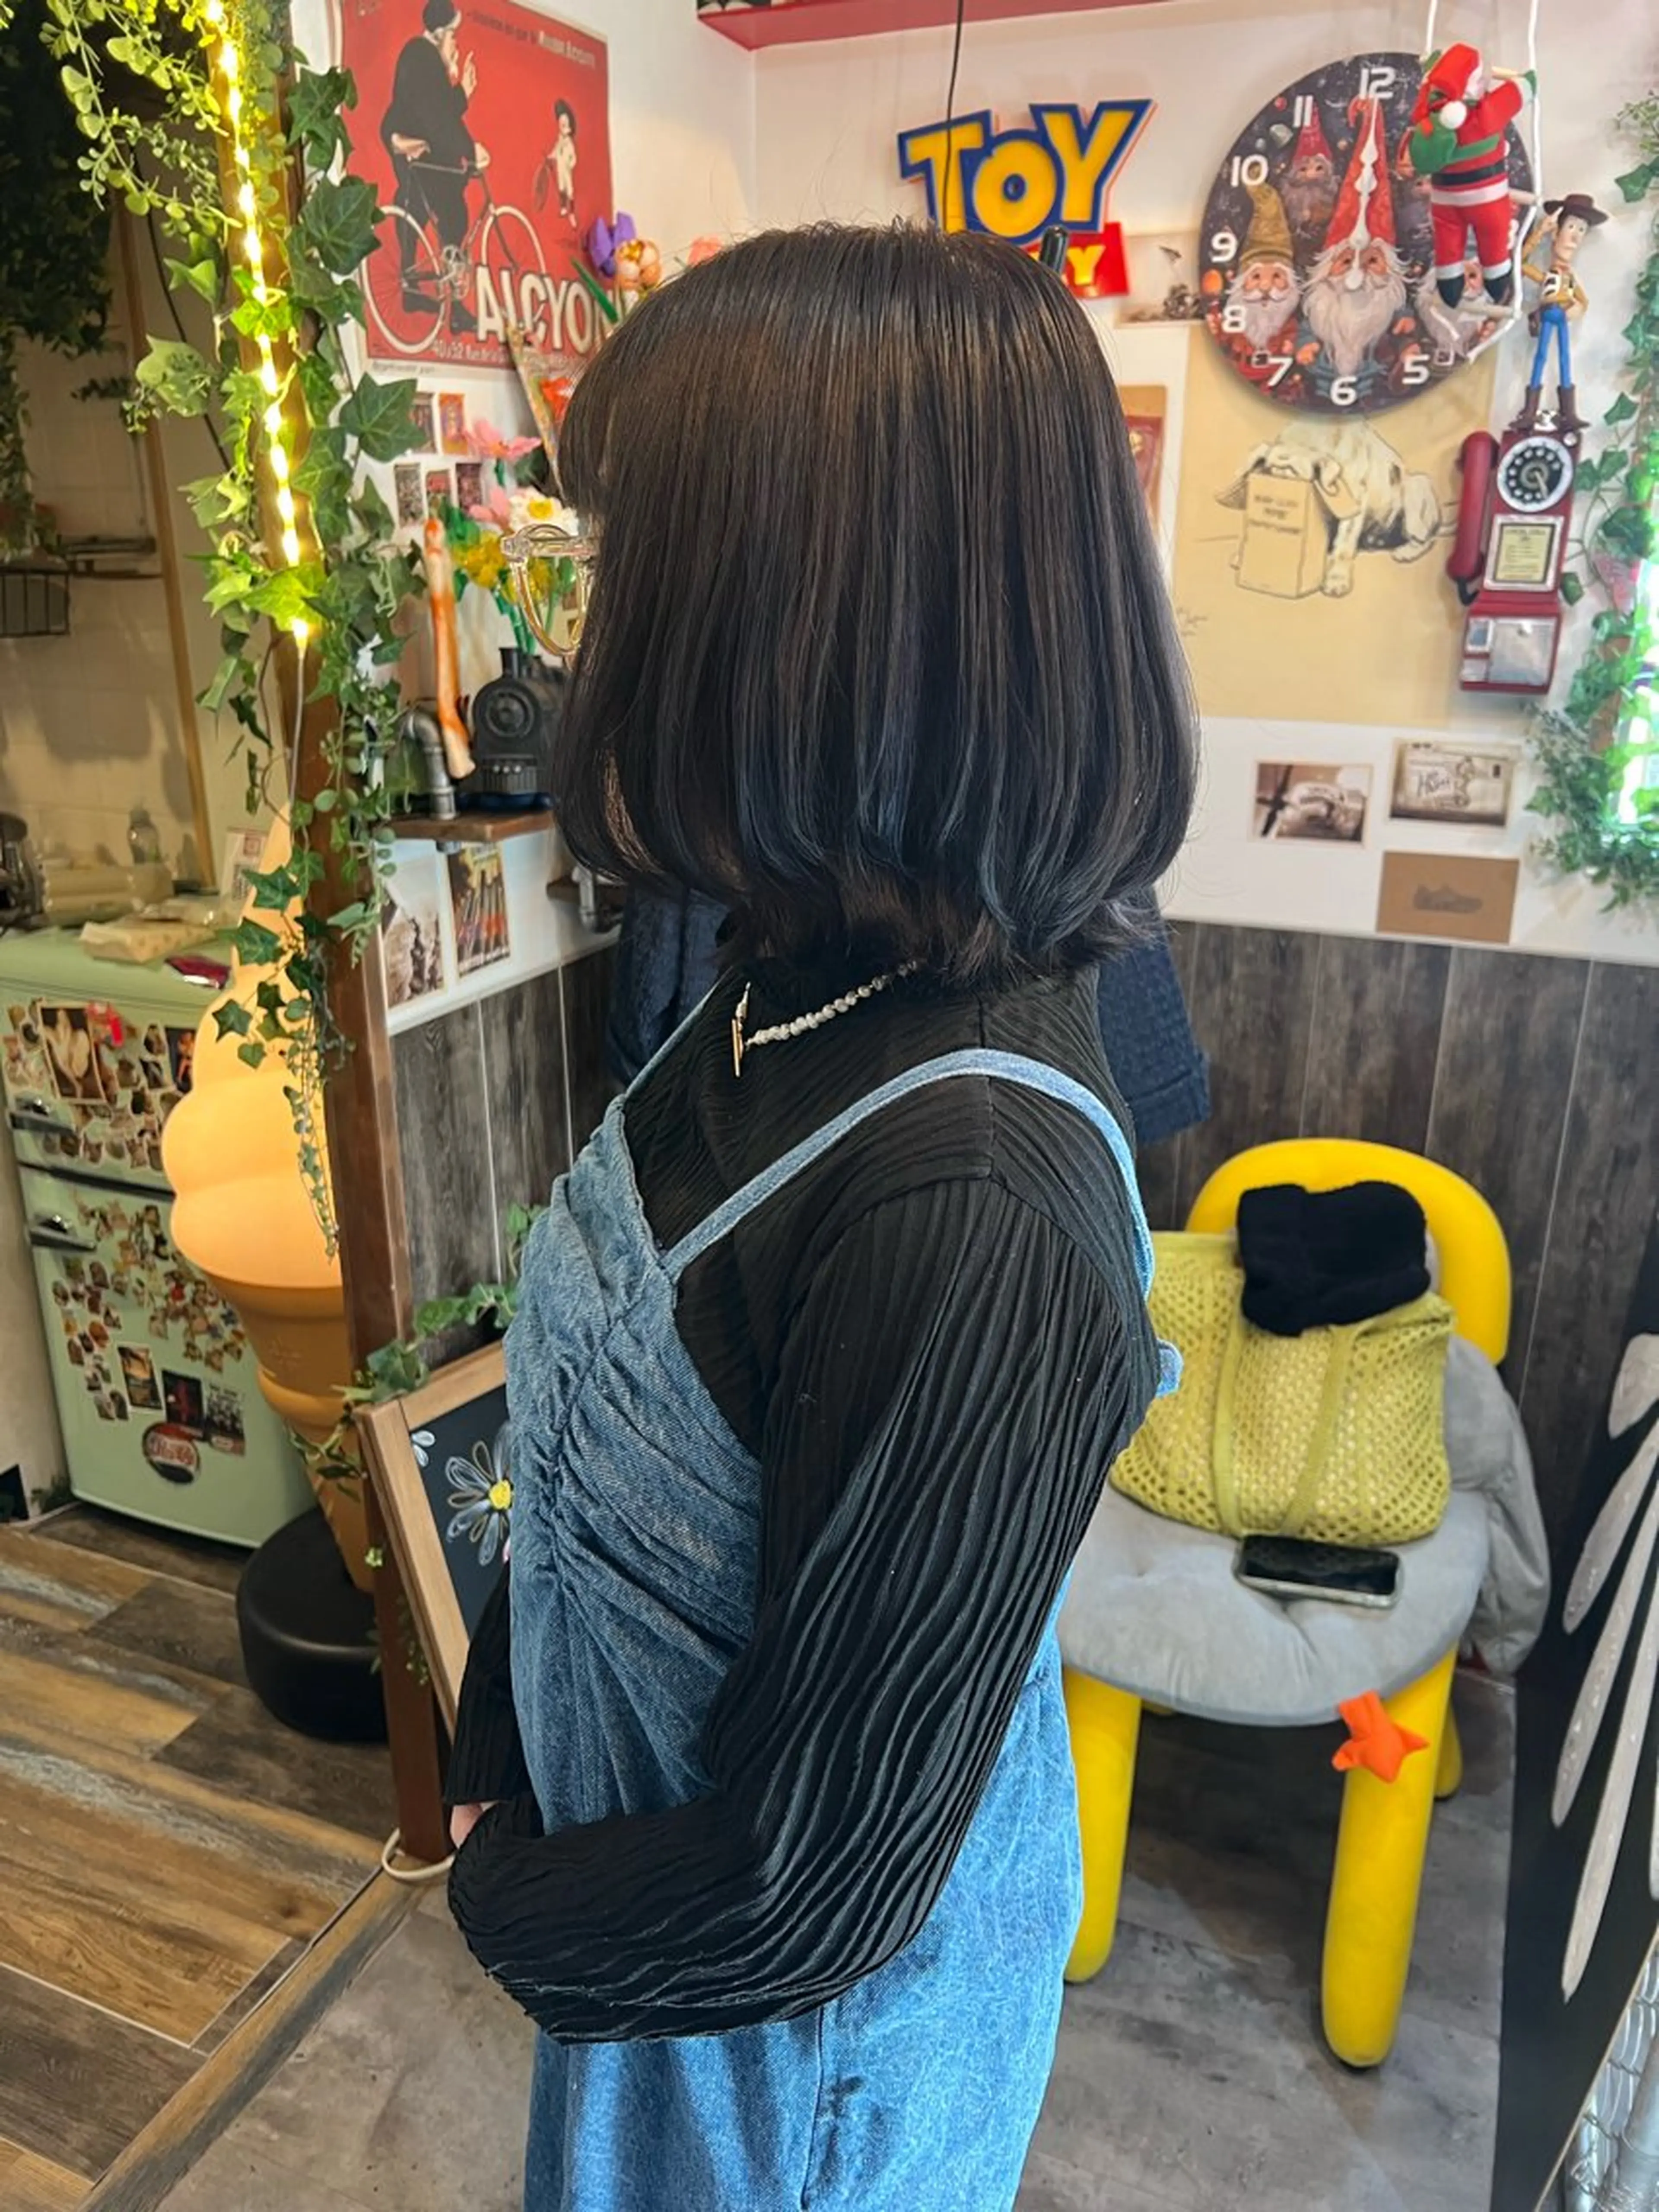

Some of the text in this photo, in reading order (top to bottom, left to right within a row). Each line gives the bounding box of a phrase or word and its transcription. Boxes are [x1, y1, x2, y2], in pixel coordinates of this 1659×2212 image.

[1358, 66, 1395, 99] 12
[1293, 95, 1313, 127] 11
[899, 101, 1149, 243] TOY
[1231, 154, 1268, 187] 10
[1211, 232, 1238, 262] 9
[1221, 304, 1246, 333] 8
[1268, 356, 1294, 386] 7
[1401, 354, 1430, 384] 5
[1330, 376, 1357, 405] 6
